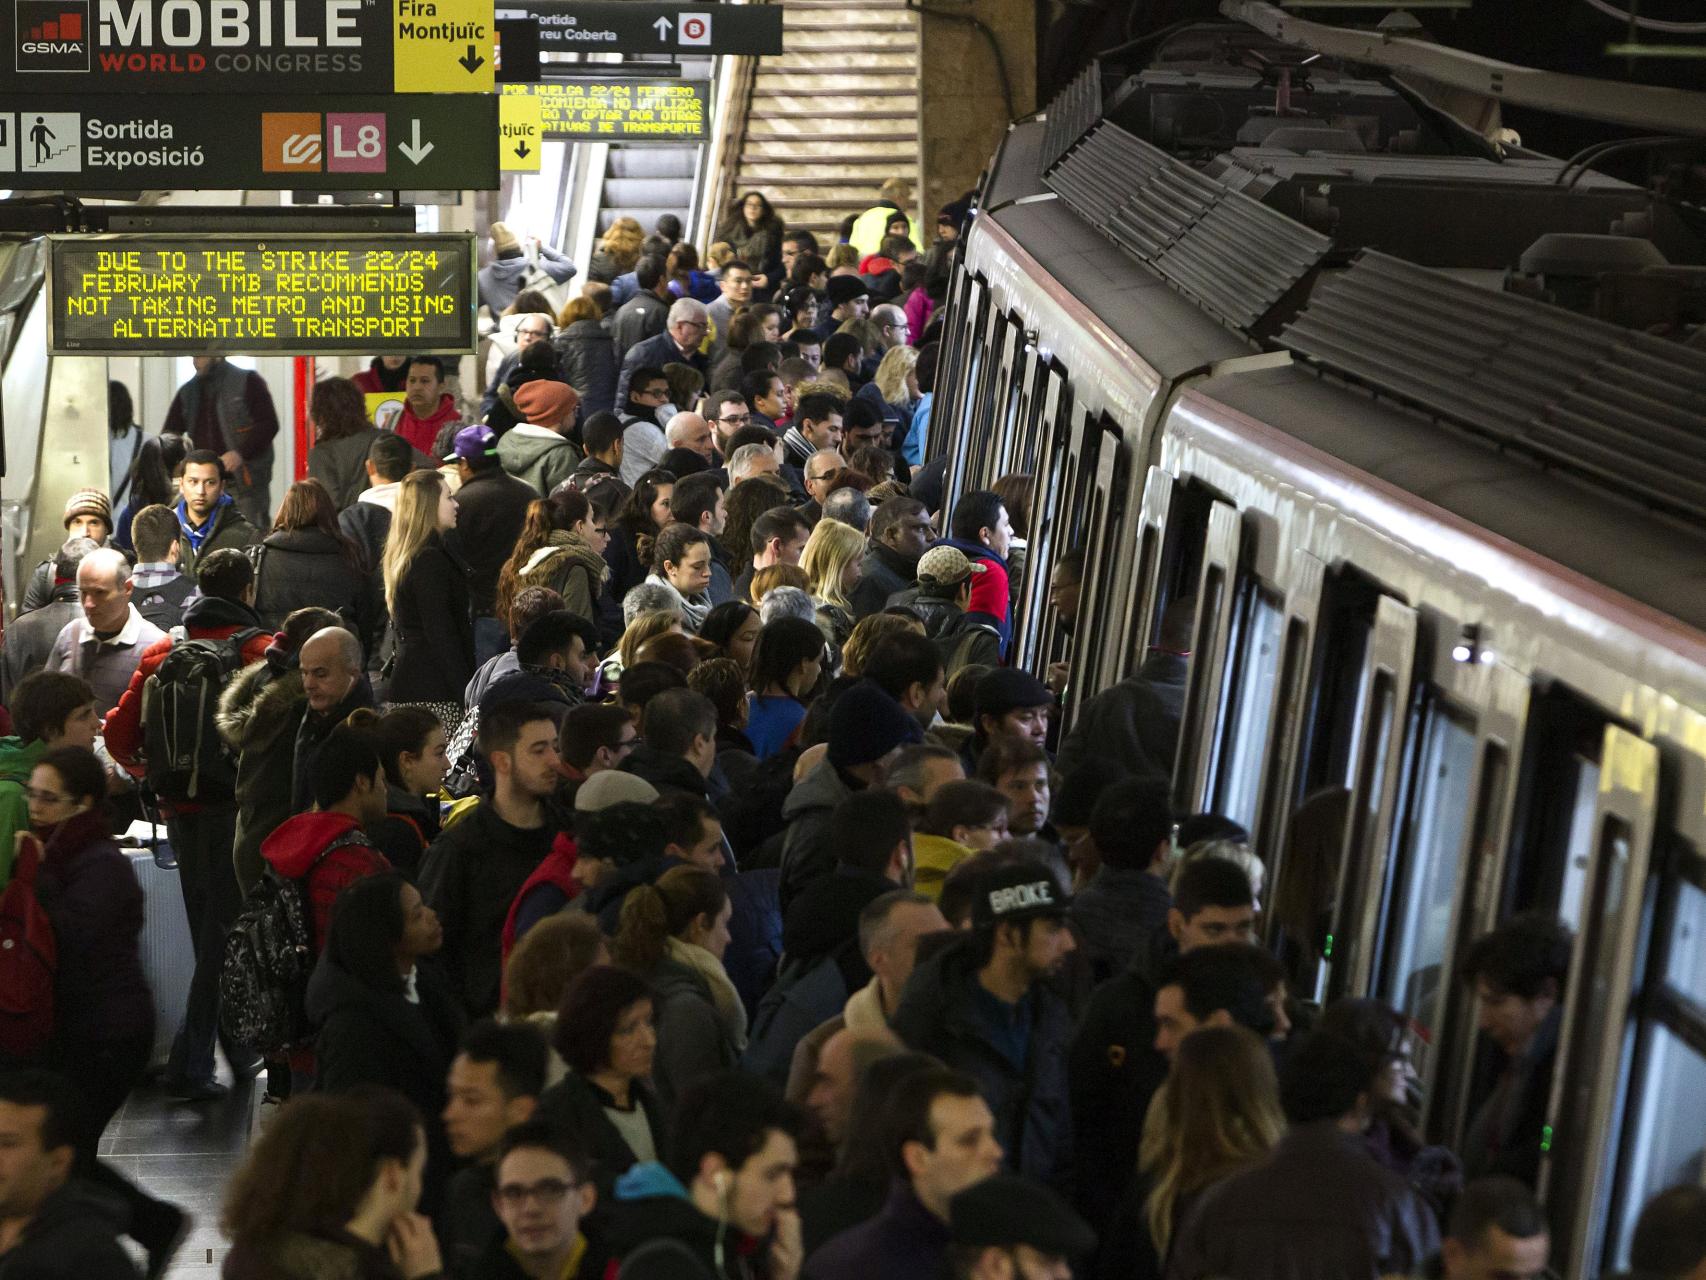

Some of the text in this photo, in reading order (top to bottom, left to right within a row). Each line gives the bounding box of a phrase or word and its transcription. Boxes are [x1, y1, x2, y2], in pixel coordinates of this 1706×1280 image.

[399, 0, 437, 17] Fira
[100, 0, 362, 46] MOBILE
[399, 22, 485, 43] Montjuïc
[539, 28, 618, 42] reu Coberta
[21, 42, 82, 54] GSMA
[100, 53, 363, 74] WORLD CONGRESS
[541, 96, 608, 110] COMIENDA
[613, 97, 632, 110] NO
[566, 109, 576, 120] Y
[629, 109, 655, 121] POR
[86, 119, 174, 140] Sortida
[499, 122, 535, 139] tjuïc
[623, 121, 703, 134] TRANSPORTE
[333, 126, 381, 159] L8
[86, 145, 205, 169] Exposició
[97, 250, 439, 272] DUE TO THE STRIKE 22/24
[82, 272, 424, 293] FEBRUARY TMB RECOMMENDS
[67, 294, 454, 316] NOT TAKING METRO AND USING
[113, 316, 425, 338] ALTERNATIVE TRANSPORT
[989, 881, 1054, 914] BROKE
